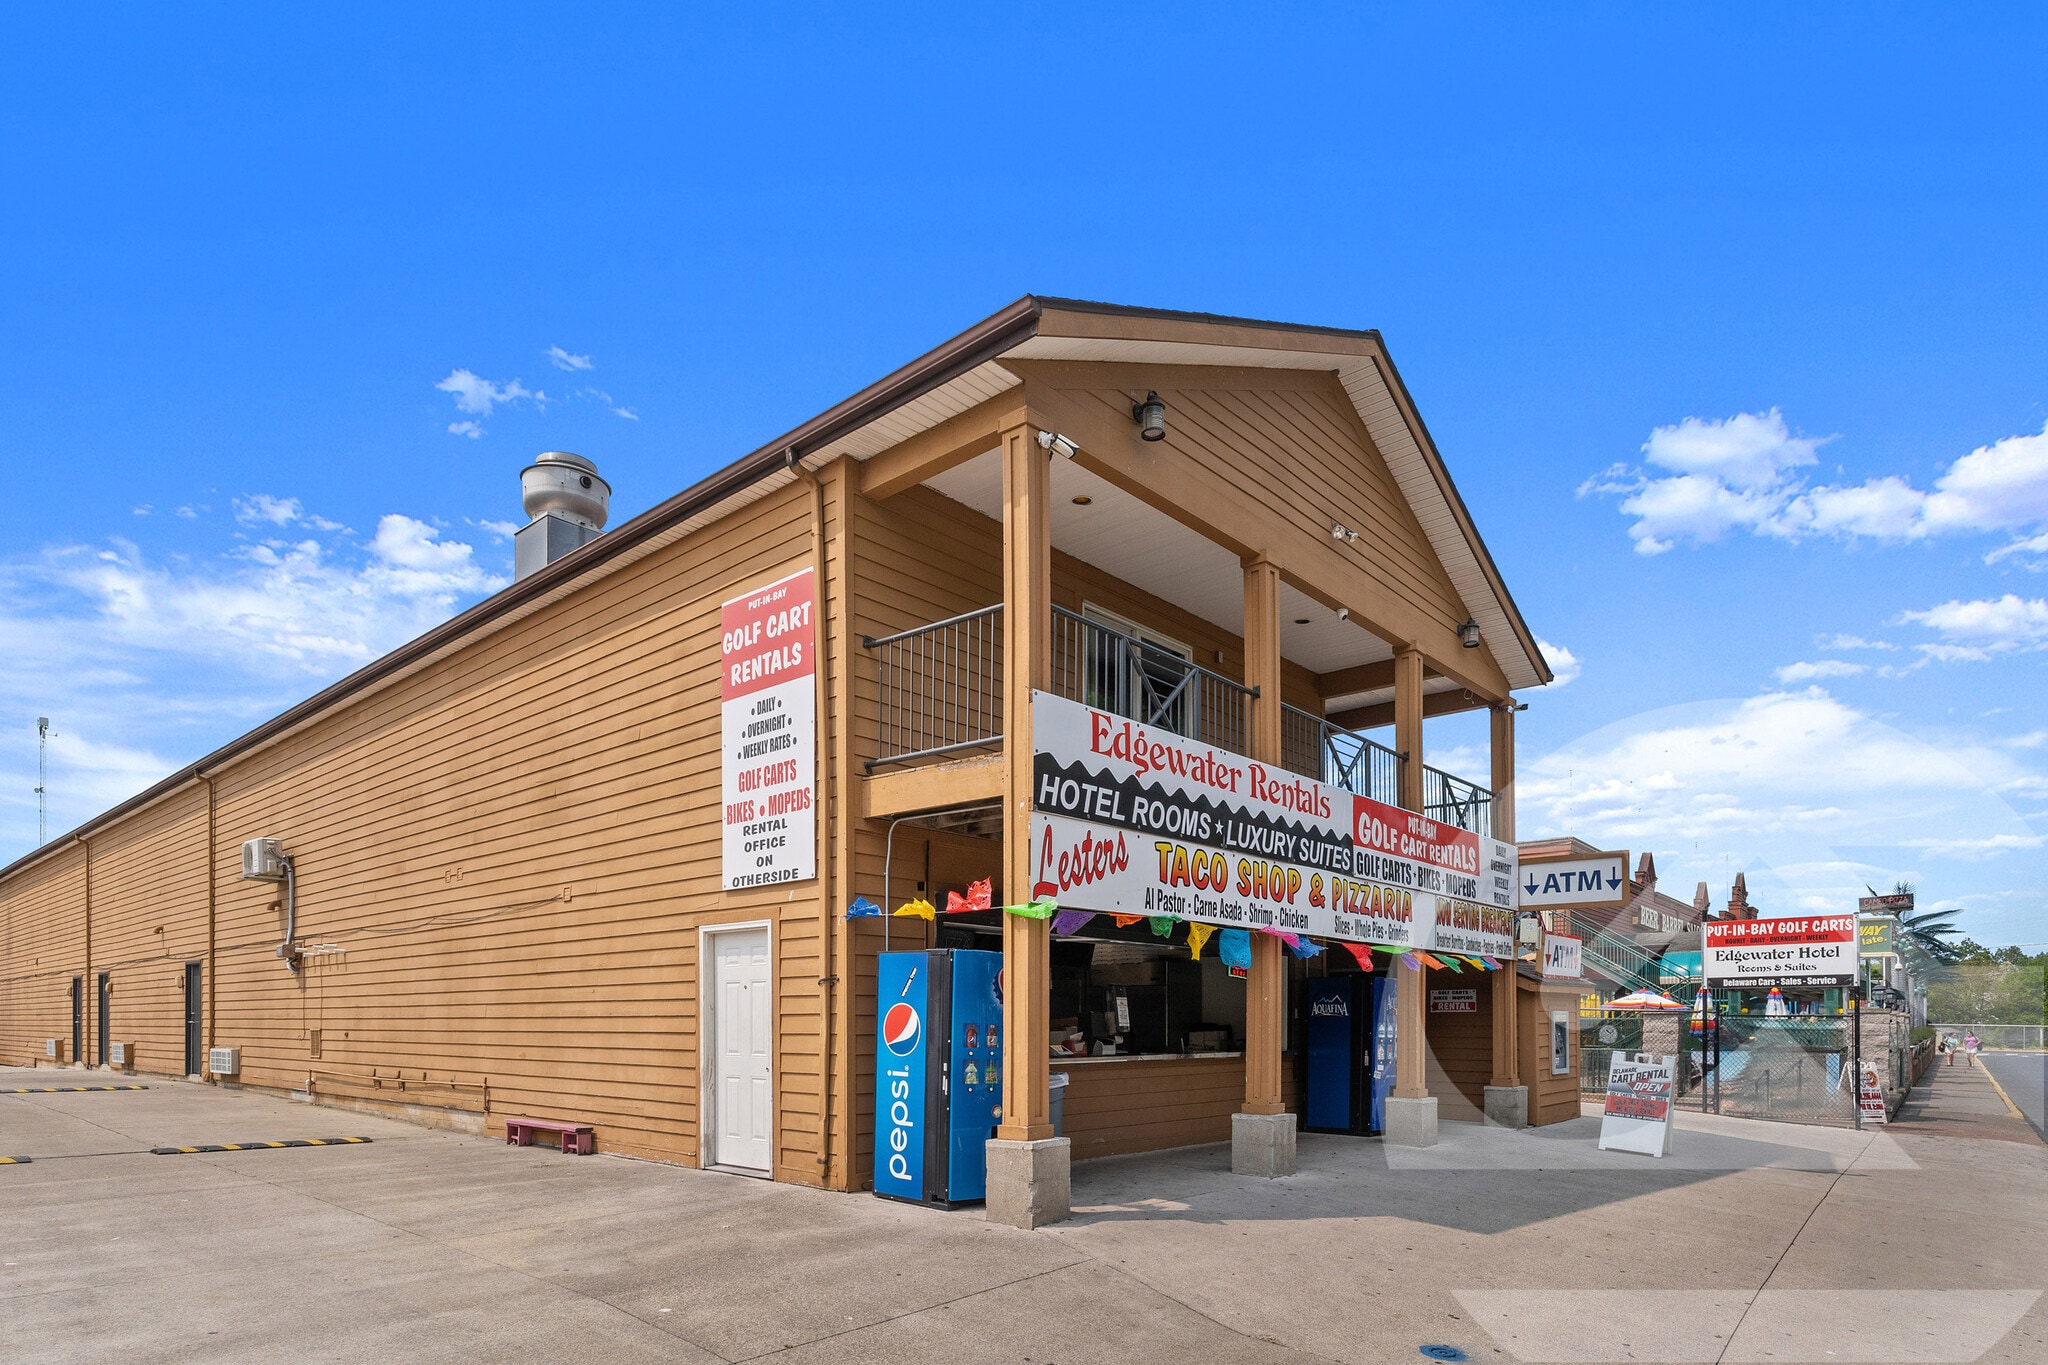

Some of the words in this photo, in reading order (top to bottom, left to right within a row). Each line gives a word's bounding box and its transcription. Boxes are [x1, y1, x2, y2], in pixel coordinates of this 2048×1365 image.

[748, 586, 787, 611] PUT-IN-BAY
[722, 620, 762, 655] GOLF
[766, 600, 812, 638] CART
[731, 642, 802, 687] RENTALS
[757, 696, 776, 716] DAILY
[747, 714, 786, 739] OVERNIGHT
[743, 741, 769, 760] WEEKLY
[769, 733, 791, 754] RATES
[738, 767, 762, 793] GOLF
[763, 758, 797, 787] CARTS
[1089, 710, 1242, 794] Edgewater
[1247, 763, 1331, 819] Rentals
[726, 799, 754, 826] BIKES
[768, 787, 811, 817] MOPEDS
[743, 818, 788, 837] RENTAL
[1038, 773, 1125, 822] HOTEL
[1131, 796, 1211, 840] ROOMS
[1226, 819, 1297, 858] LUXURY
[1299, 837, 1351, 871] SUITES
[1407, 816, 1437, 840] PUT-IN-BAY
[744, 835, 786, 853] OFFICE
[1358, 811, 1398, 851] GOLF
[1400, 833, 1428, 859] CART
[1429, 844, 1476, 872] RENTALS
[756, 854, 773, 868] ON
[1033, 824, 1130, 901] Lesters
[732, 868, 799, 888] OTHERSIDE
[1154, 841, 1229, 893] TACO
[1236, 858, 1302, 904] SHOP
[1308, 872, 1325, 909] &
[1331, 876, 1413, 923] PIZZARIA
[1356, 851, 1380, 879] GOLF
[1382, 857, 1412, 885] CARTS
[1417, 866, 1440, 892] BIKES
[1445, 873, 1476, 899] MOPEDS
[1542, 870, 1602, 894] ATM
[1144, 887, 1154, 910] Al
[1157, 888, 1186, 914] Pastor
[1193, 893, 1217, 918] Carne
[1219, 898, 1242, 921] Asada
[1249, 902, 1273, 927] Shrimp
[1279, 907, 1309, 929] Chicken
[1640, 905, 1659, 930] BEER
[1334, 915, 1350, 935] Slices
[1354, 918, 1371, 938] Whole
[1372, 921, 1384, 939] Pies
[1387, 923, 1409, 942] Grinders
[1707, 921, 1775, 938] PUT-IN-BAY
[1777, 921, 1809, 934] GOLF
[1812, 918, 1853, 932] CARTS
[1770, 935, 1801, 943] OVERNIGHT
[1860, 924, 1888, 936] WAY
[1861, 936, 1888, 946] late.
[1552, 945, 1574, 969] ATM
[1715, 948, 1794, 964] Edgewater
[1798, 945, 1840, 959] Hotel
[1737, 964, 1772, 973] Rooms
[1784, 963, 1817, 971] Suites
[1723, 978, 1757, 987] Delaware
[1758, 978, 1775, 986] Cars
[1780, 977, 1802, 986] Sales
[1807, 976, 1837, 985] Service
[1311, 1002, 1349, 1016] AQUAFINA
[1438, 1002, 1470, 1010] RENTAL
[1611, 1073, 1634, 1083] CART
[1636, 1069, 1669, 1081] RENTAL
[1633, 1082, 1664, 1092] OPEN
[887, 1069, 913, 1180] pepsi
